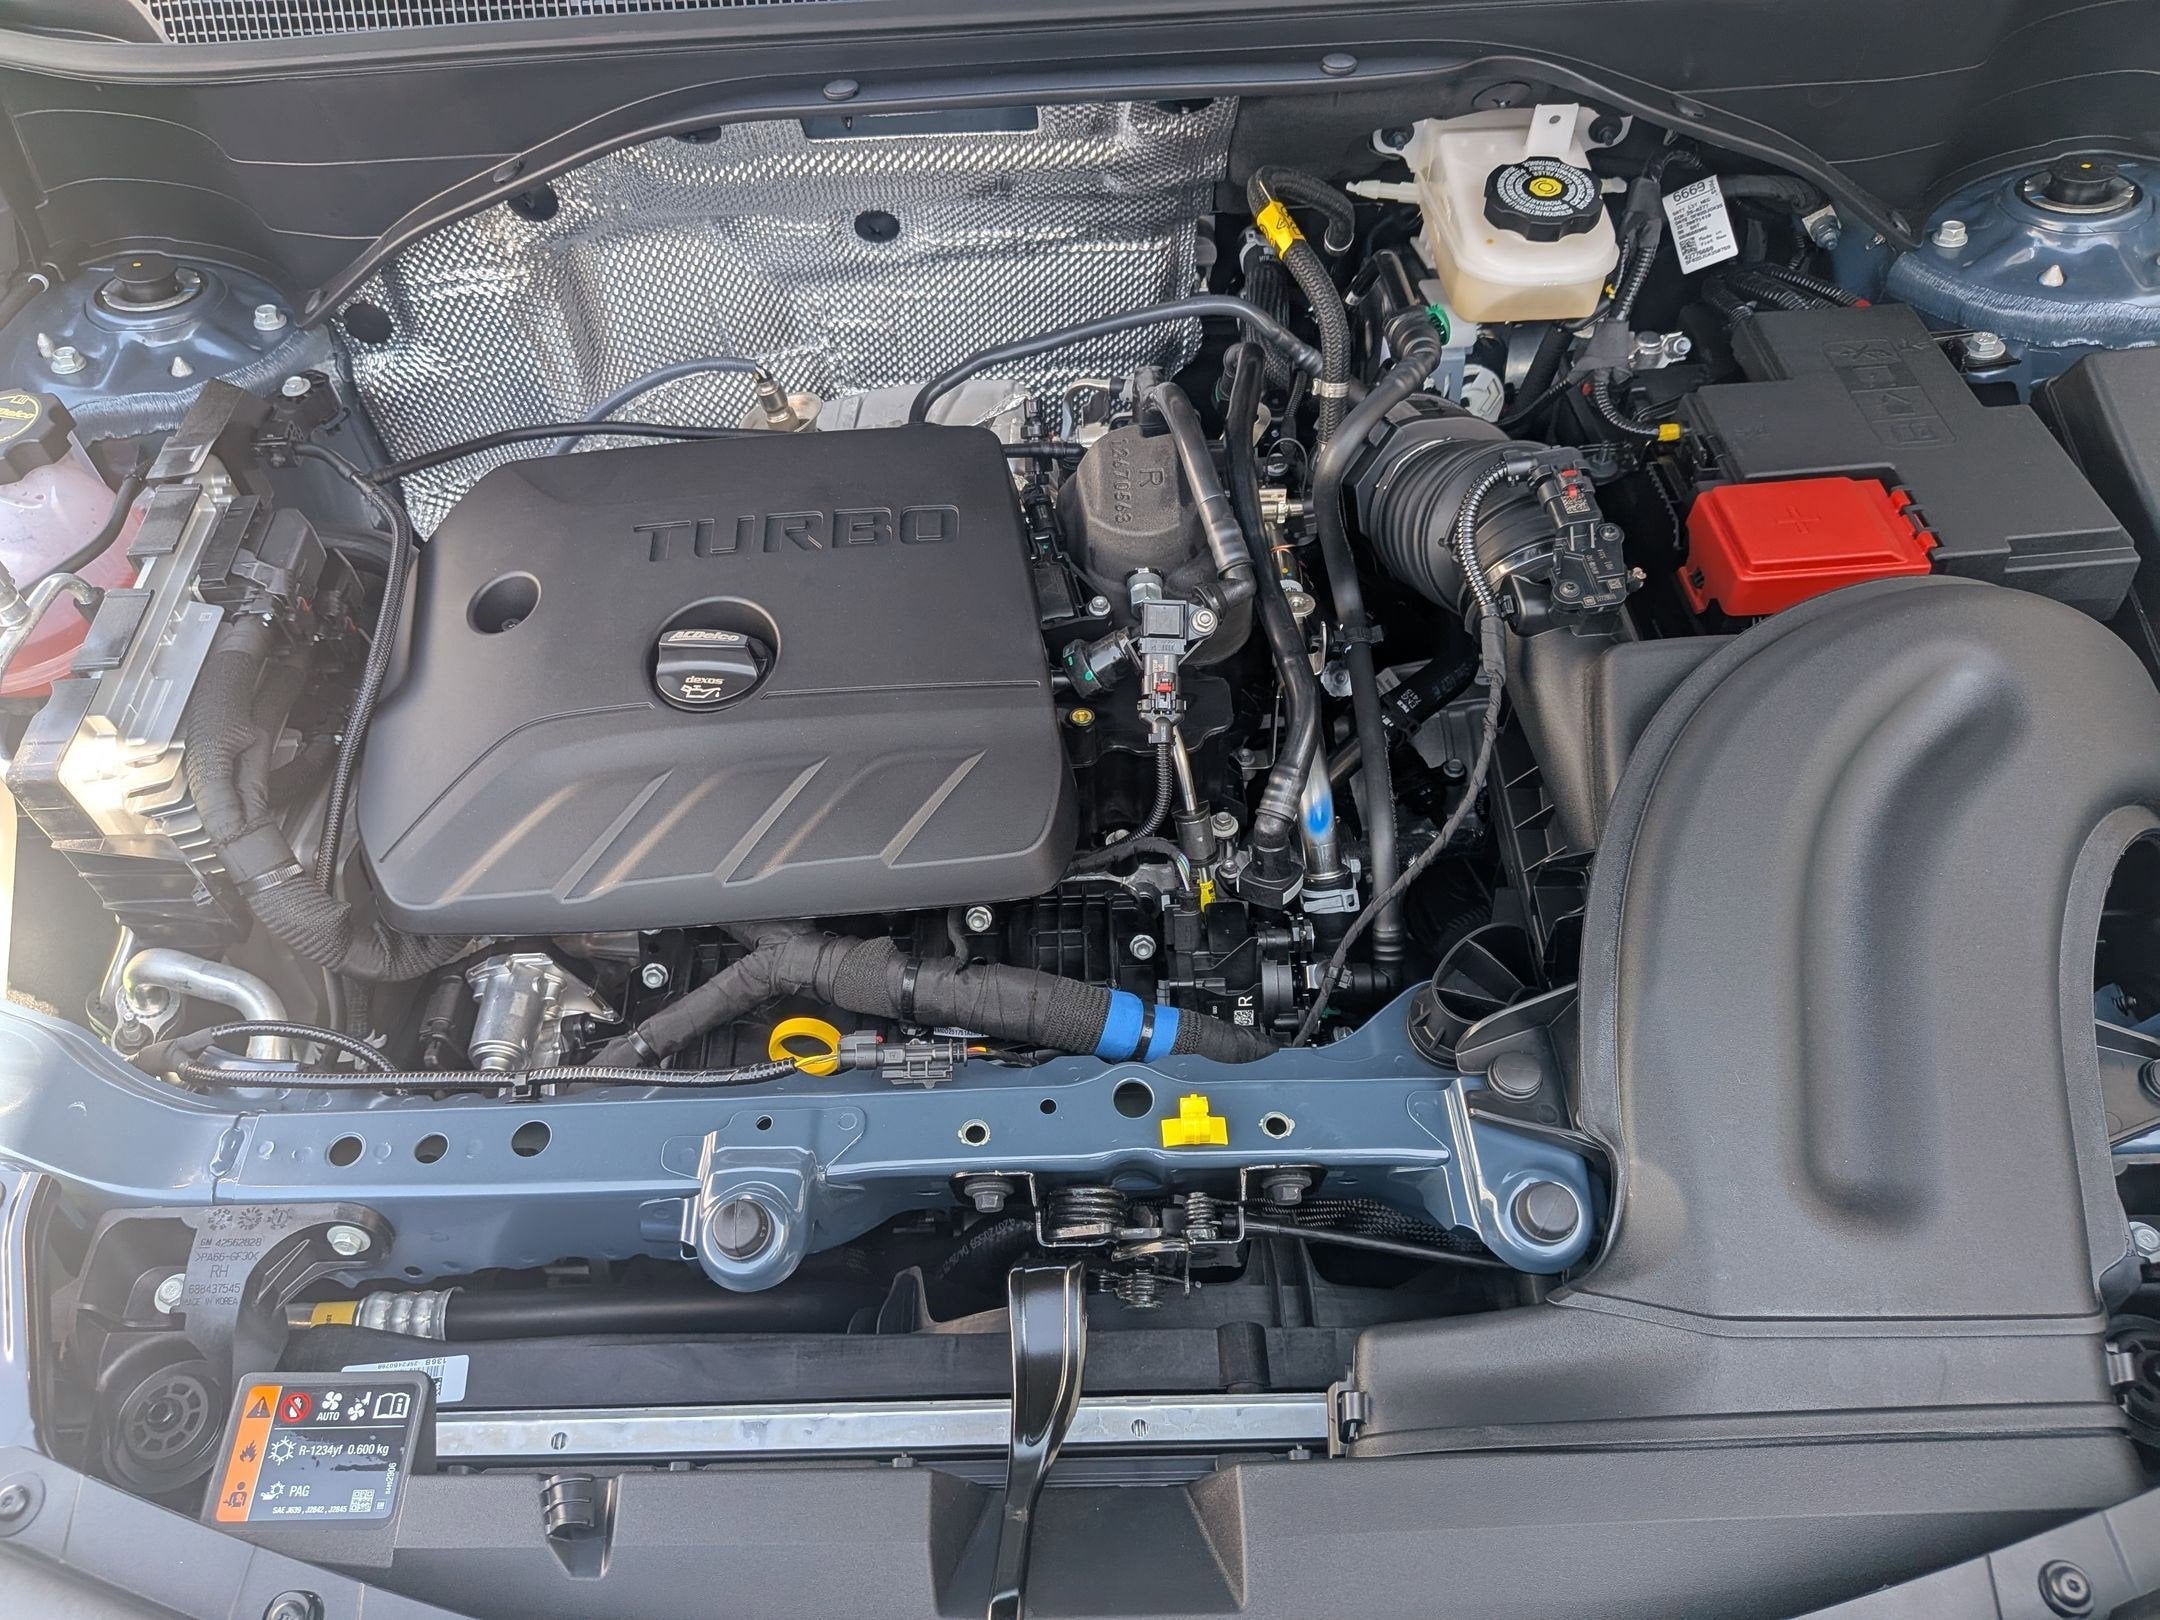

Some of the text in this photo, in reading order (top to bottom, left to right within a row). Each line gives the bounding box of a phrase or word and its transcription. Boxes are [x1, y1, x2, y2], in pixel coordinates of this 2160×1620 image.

[1673, 181, 1707, 202] 6669
[1138, 467, 1164, 488] R
[633, 504, 960, 562] TURBO
[668, 630, 740, 642] ACDelco
[685, 675, 725, 685] dexos
[1238, 995, 1253, 1007] R
[210, 1264, 230, 1278] RH
[215, 1296, 238, 1306] KOREA
[316, 1411, 340, 1421] AUTO
[298, 1443, 390, 1458] R-1234yf 0.600 kg
[288, 1485, 311, 1497] PAG
[272, 1506, 287, 1514] SAE
